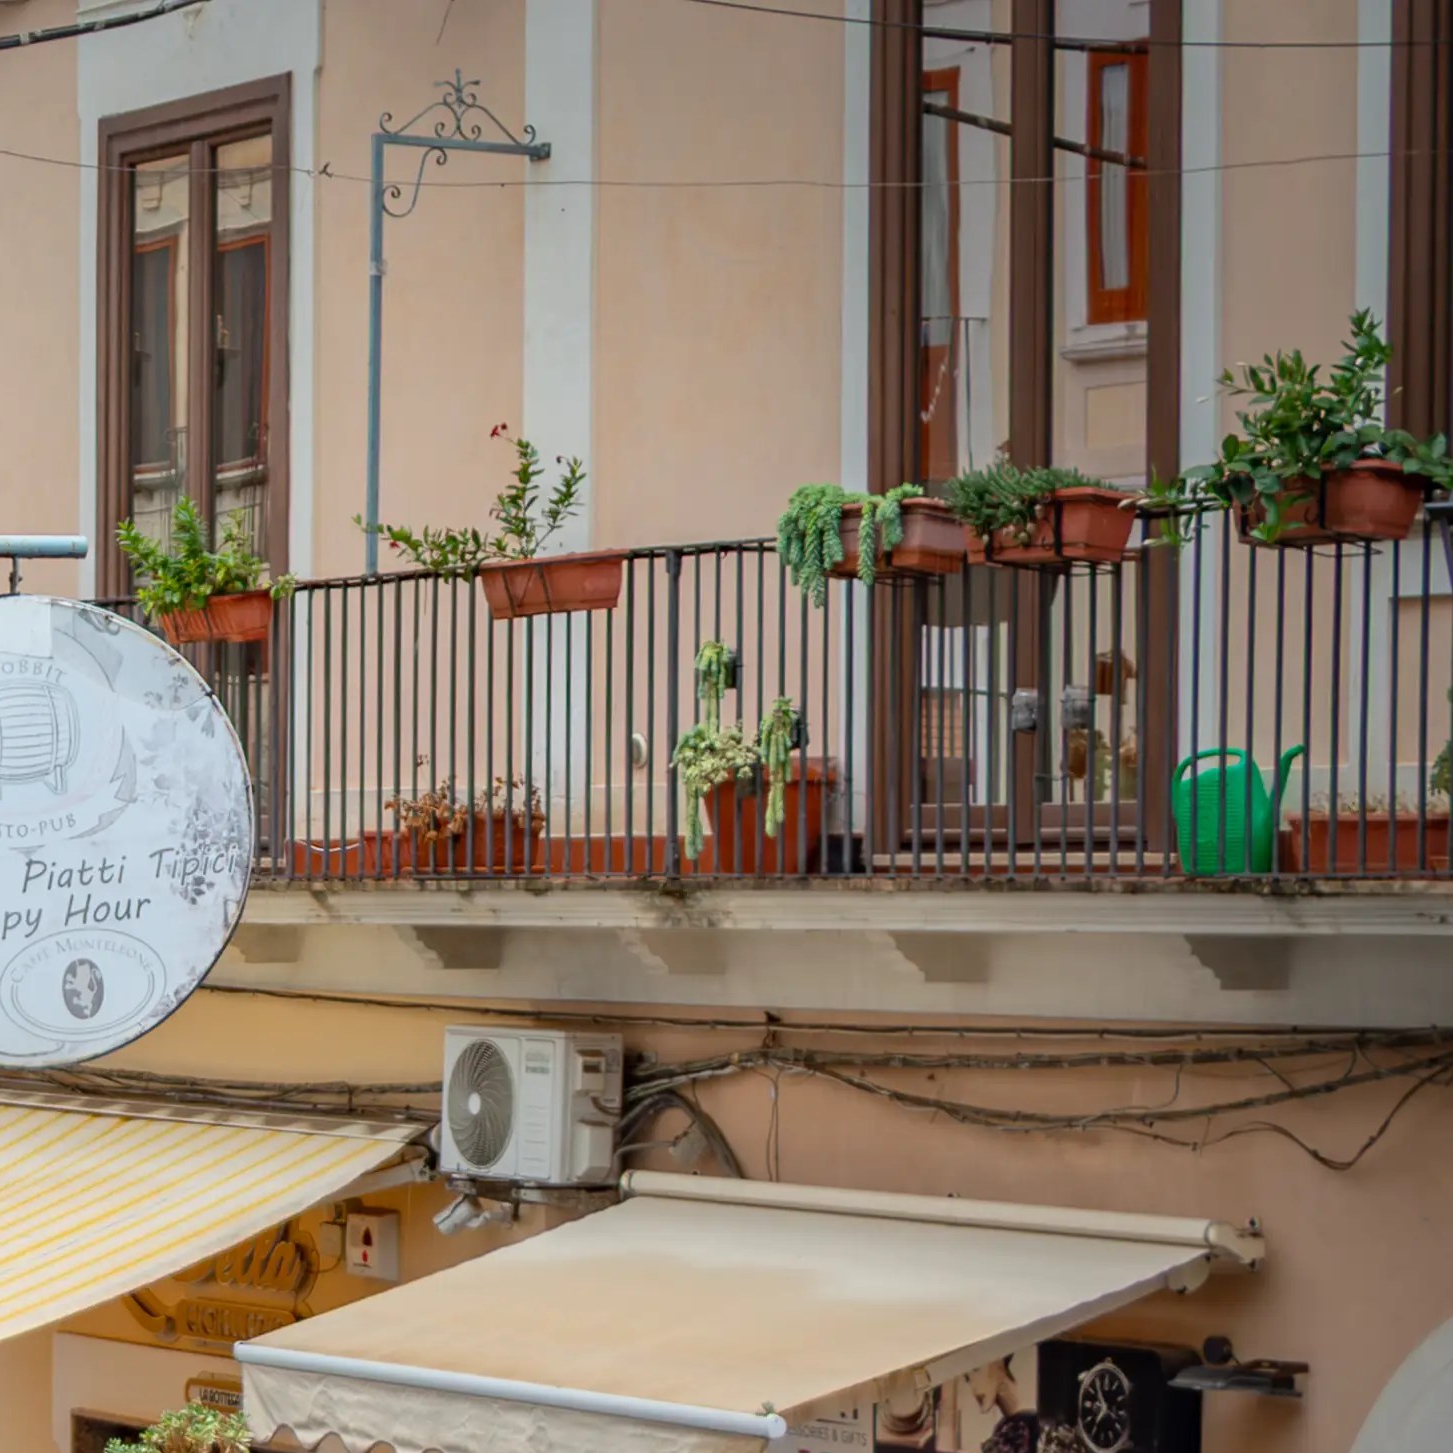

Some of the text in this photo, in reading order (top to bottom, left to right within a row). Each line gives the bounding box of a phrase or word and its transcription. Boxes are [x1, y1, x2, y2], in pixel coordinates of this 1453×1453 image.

[22, 855, 127, 893] Piatti
[149, 844, 237, 887] Tipici
[64, 893, 151, 926] Hour
